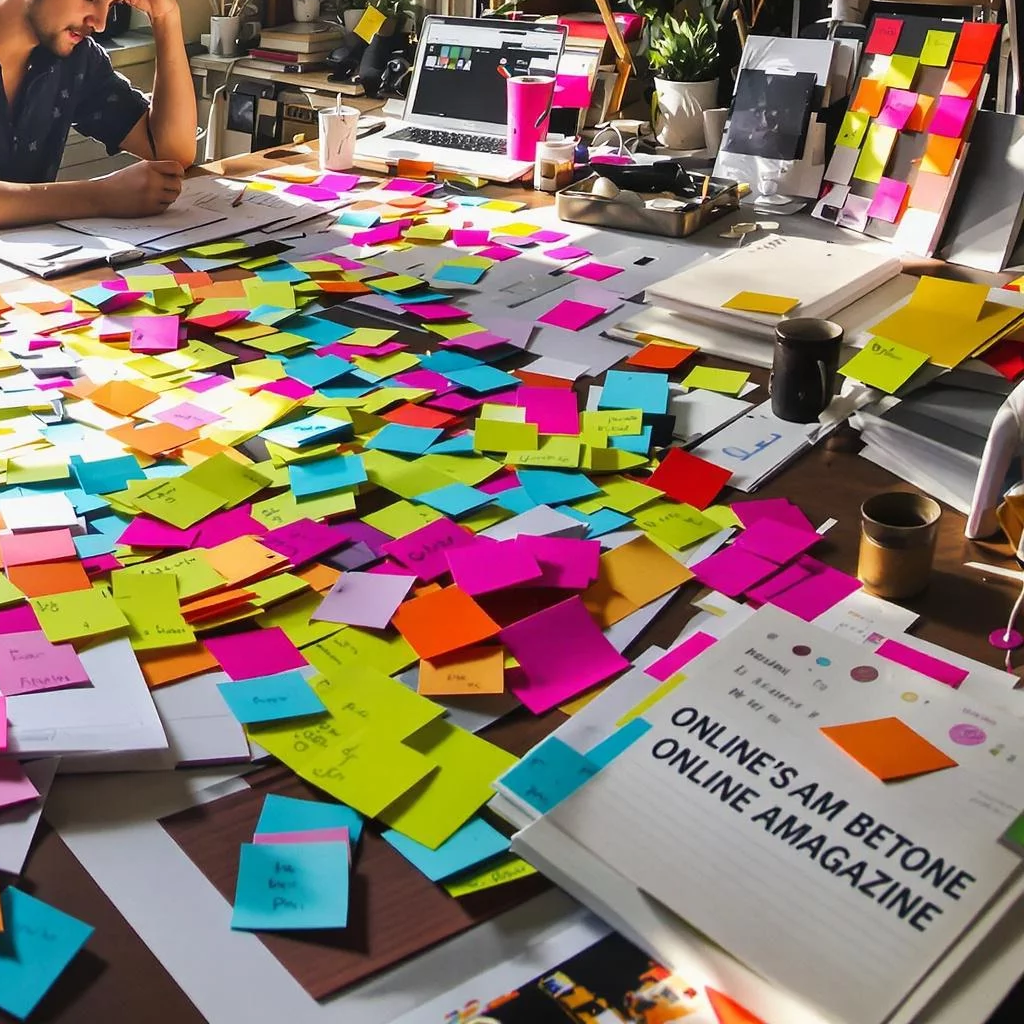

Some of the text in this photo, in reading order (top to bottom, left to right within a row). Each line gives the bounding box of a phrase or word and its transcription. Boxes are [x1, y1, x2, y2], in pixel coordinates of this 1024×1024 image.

[651, 738, 943, 932] ONLINE AMAGAZINE
[671, 707, 976, 901] ONLINE'S AM BETONE
